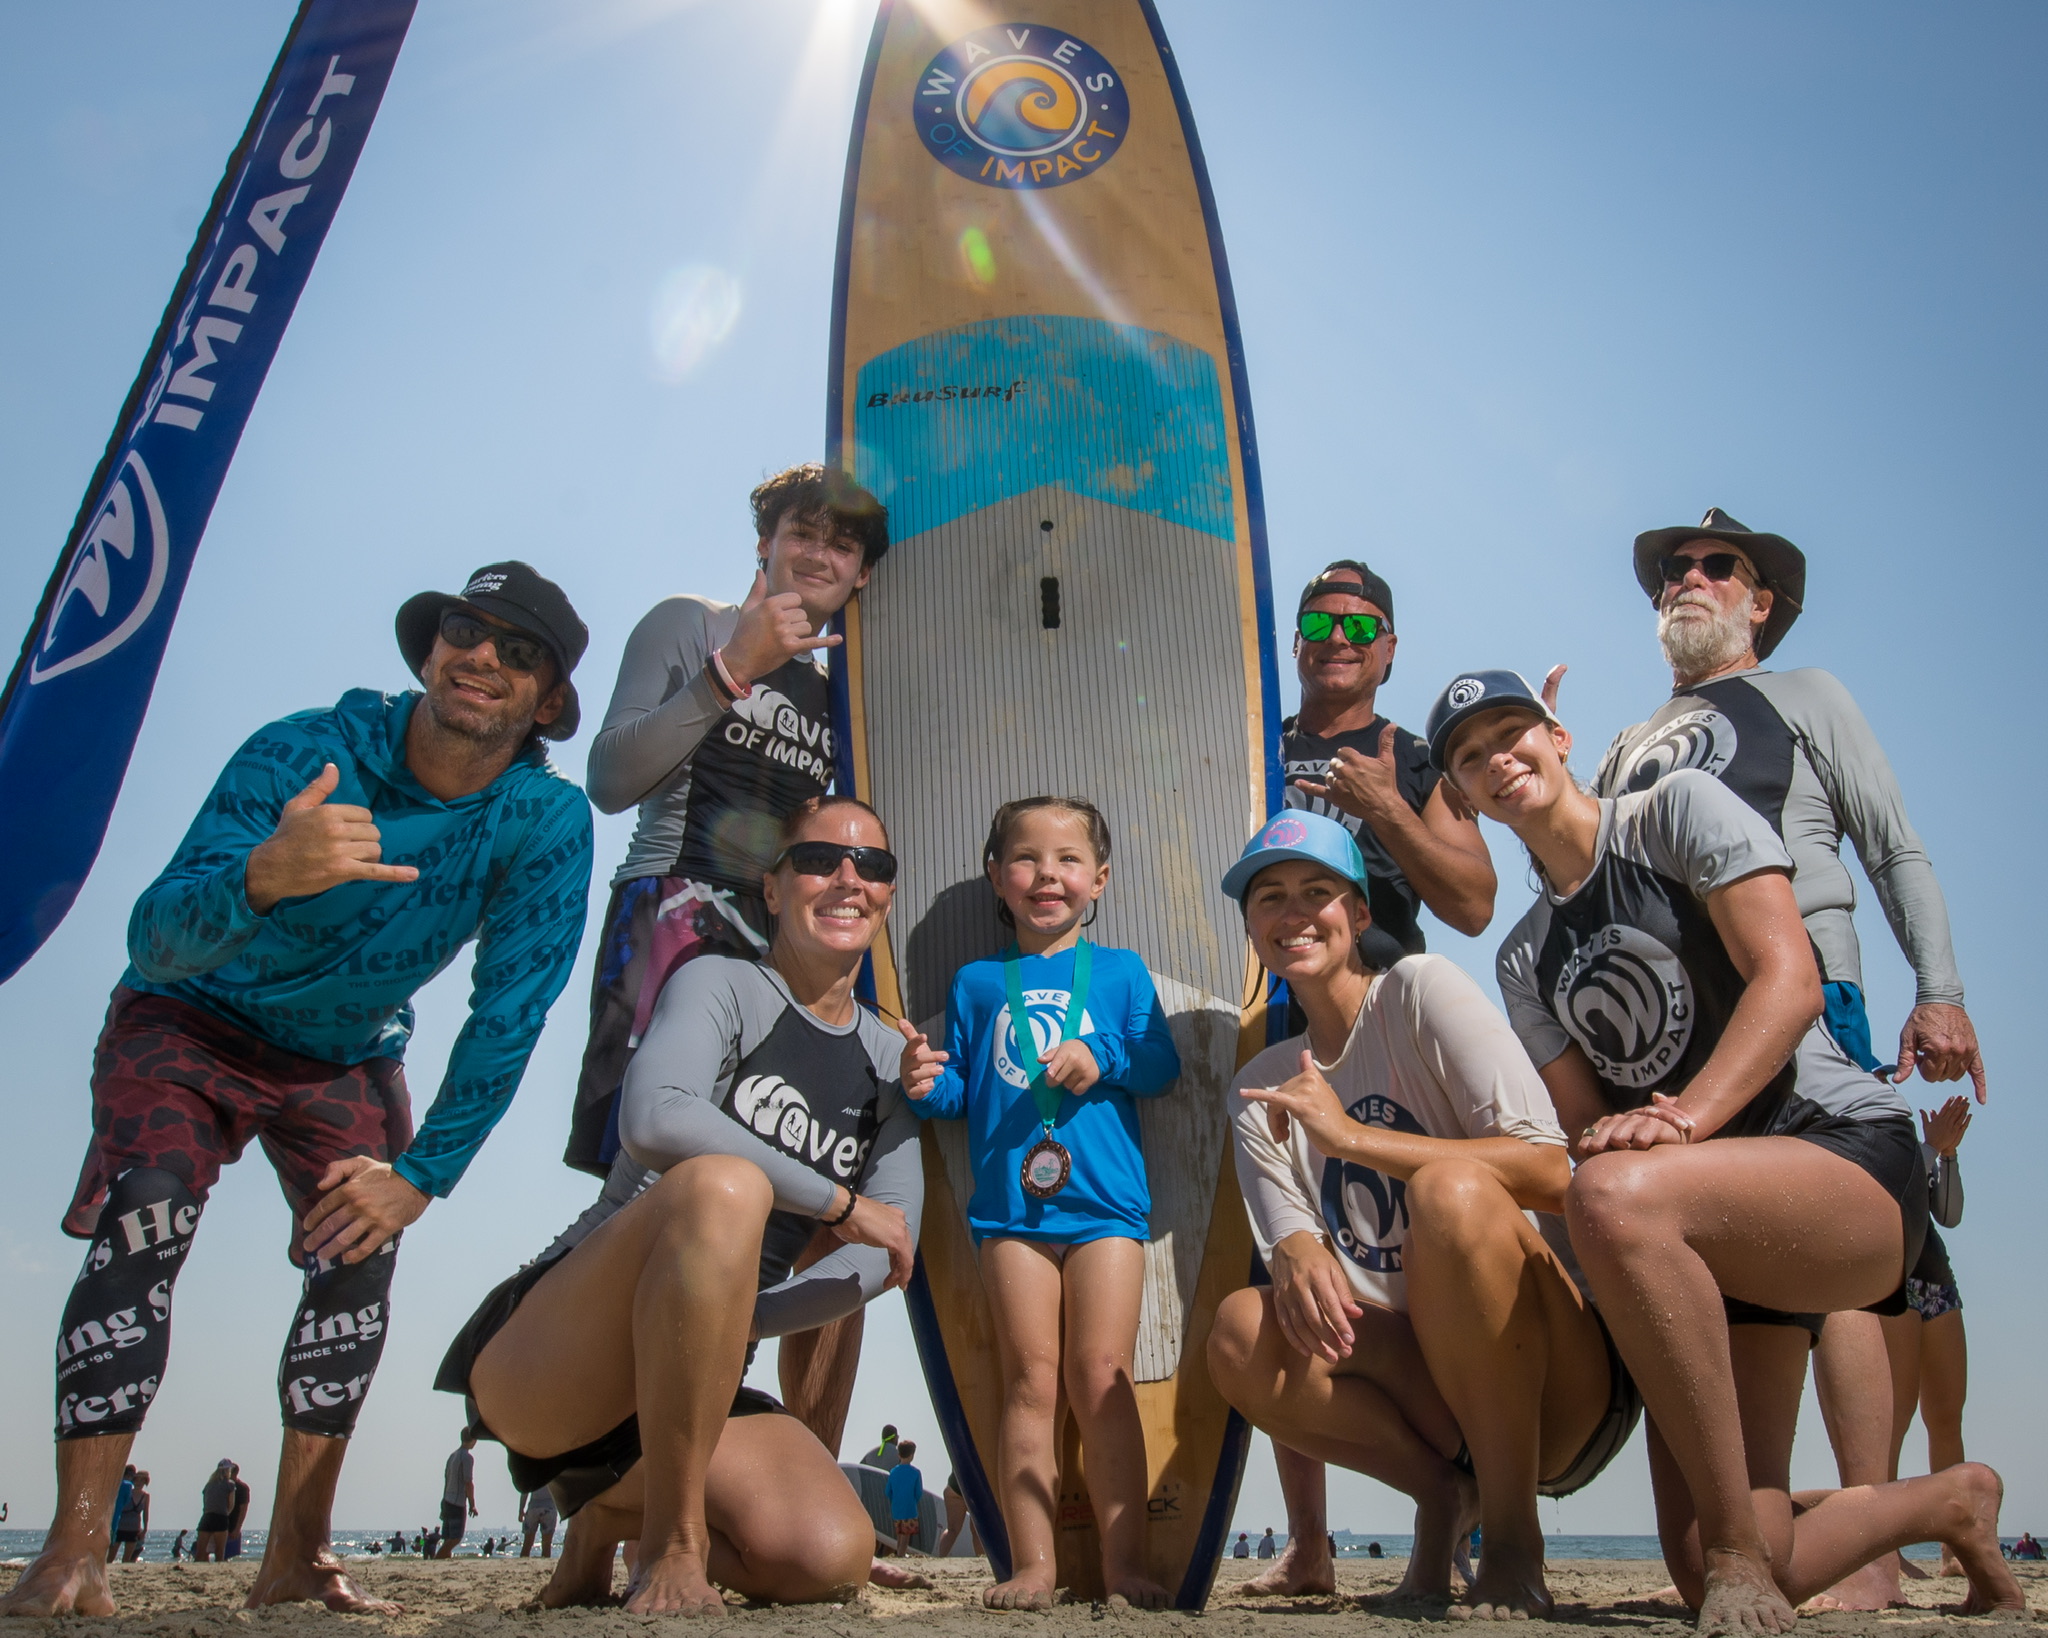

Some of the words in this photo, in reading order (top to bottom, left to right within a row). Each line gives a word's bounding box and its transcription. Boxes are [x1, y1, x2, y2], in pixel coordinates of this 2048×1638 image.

[922, 28, 1114, 96] WAVES
[930, 122, 973, 157] OF
[980, 119, 1116, 184] IMPACT
[153, 54, 357, 432] IMPACT
[724, 722, 766, 750] OF
[1642, 712, 1717, 747] WAVES
[527, 834, 544, 853] THE
[1557, 929, 1622, 993] WAVES
[1631, 981, 1690, 1083] IMPACT
[998, 1056, 1017, 1078] OF
[156, 1246, 178, 1261] THE
[1337, 1227, 1369, 1259] OF
[58, 1359, 88, 1382] SINCE
[290, 1346, 332, 1363] SINCE
